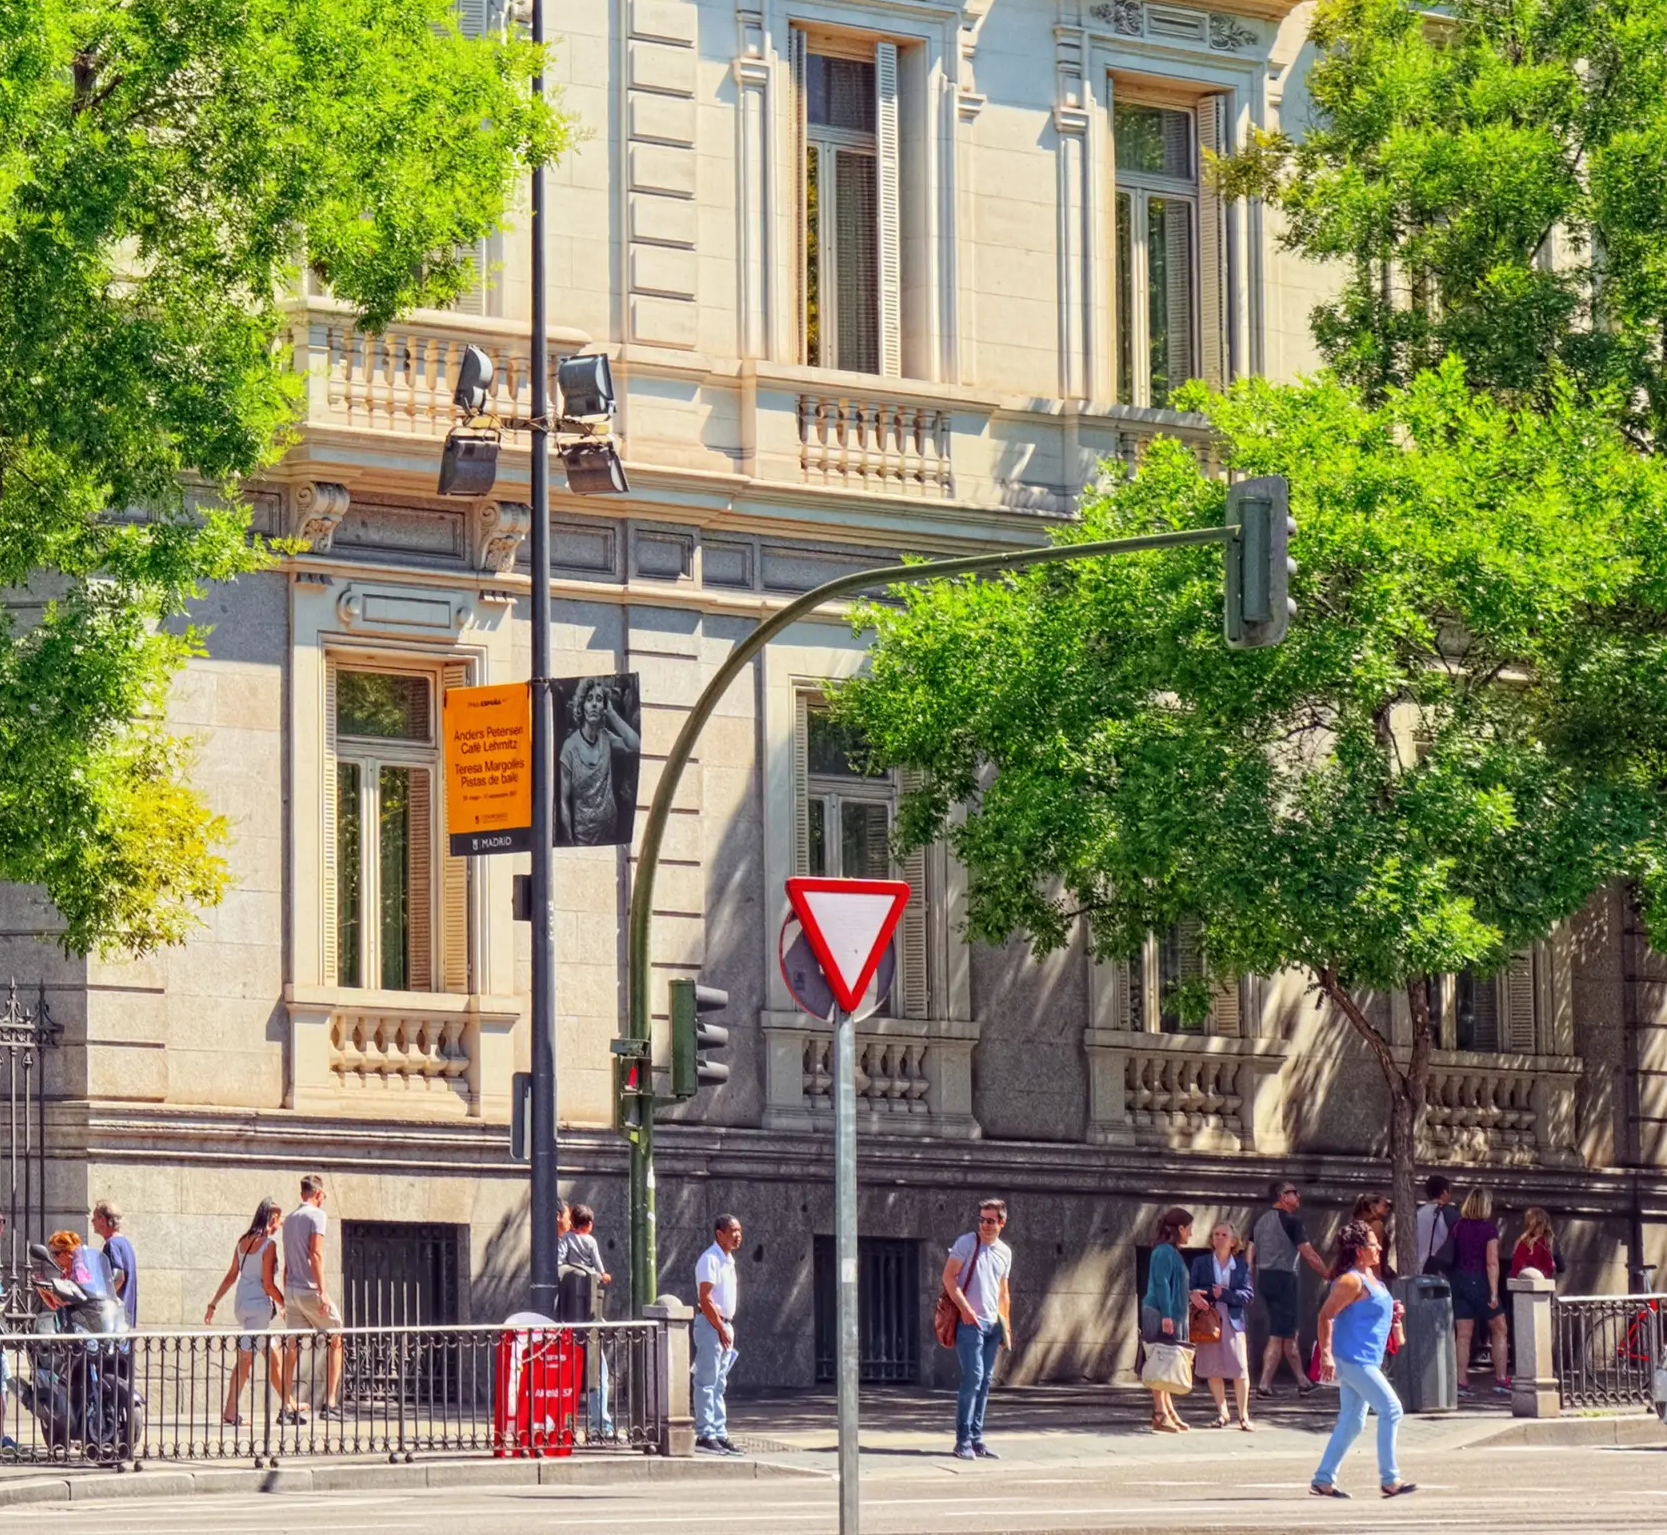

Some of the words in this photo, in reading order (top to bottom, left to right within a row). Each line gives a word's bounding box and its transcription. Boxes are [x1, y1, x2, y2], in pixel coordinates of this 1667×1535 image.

[455, 729, 485, 742] Anders
[487, 726, 523, 738] Petersen
[461, 741, 481, 754] Café
[483, 739, 517, 752] Lehmitz
[455, 763, 483, 775] Teresa
[461, 776, 486, 788] Pistas
[488, 774, 499, 785] de
[501, 772, 518, 784] baile
[482, 836, 512, 848] MADRID
